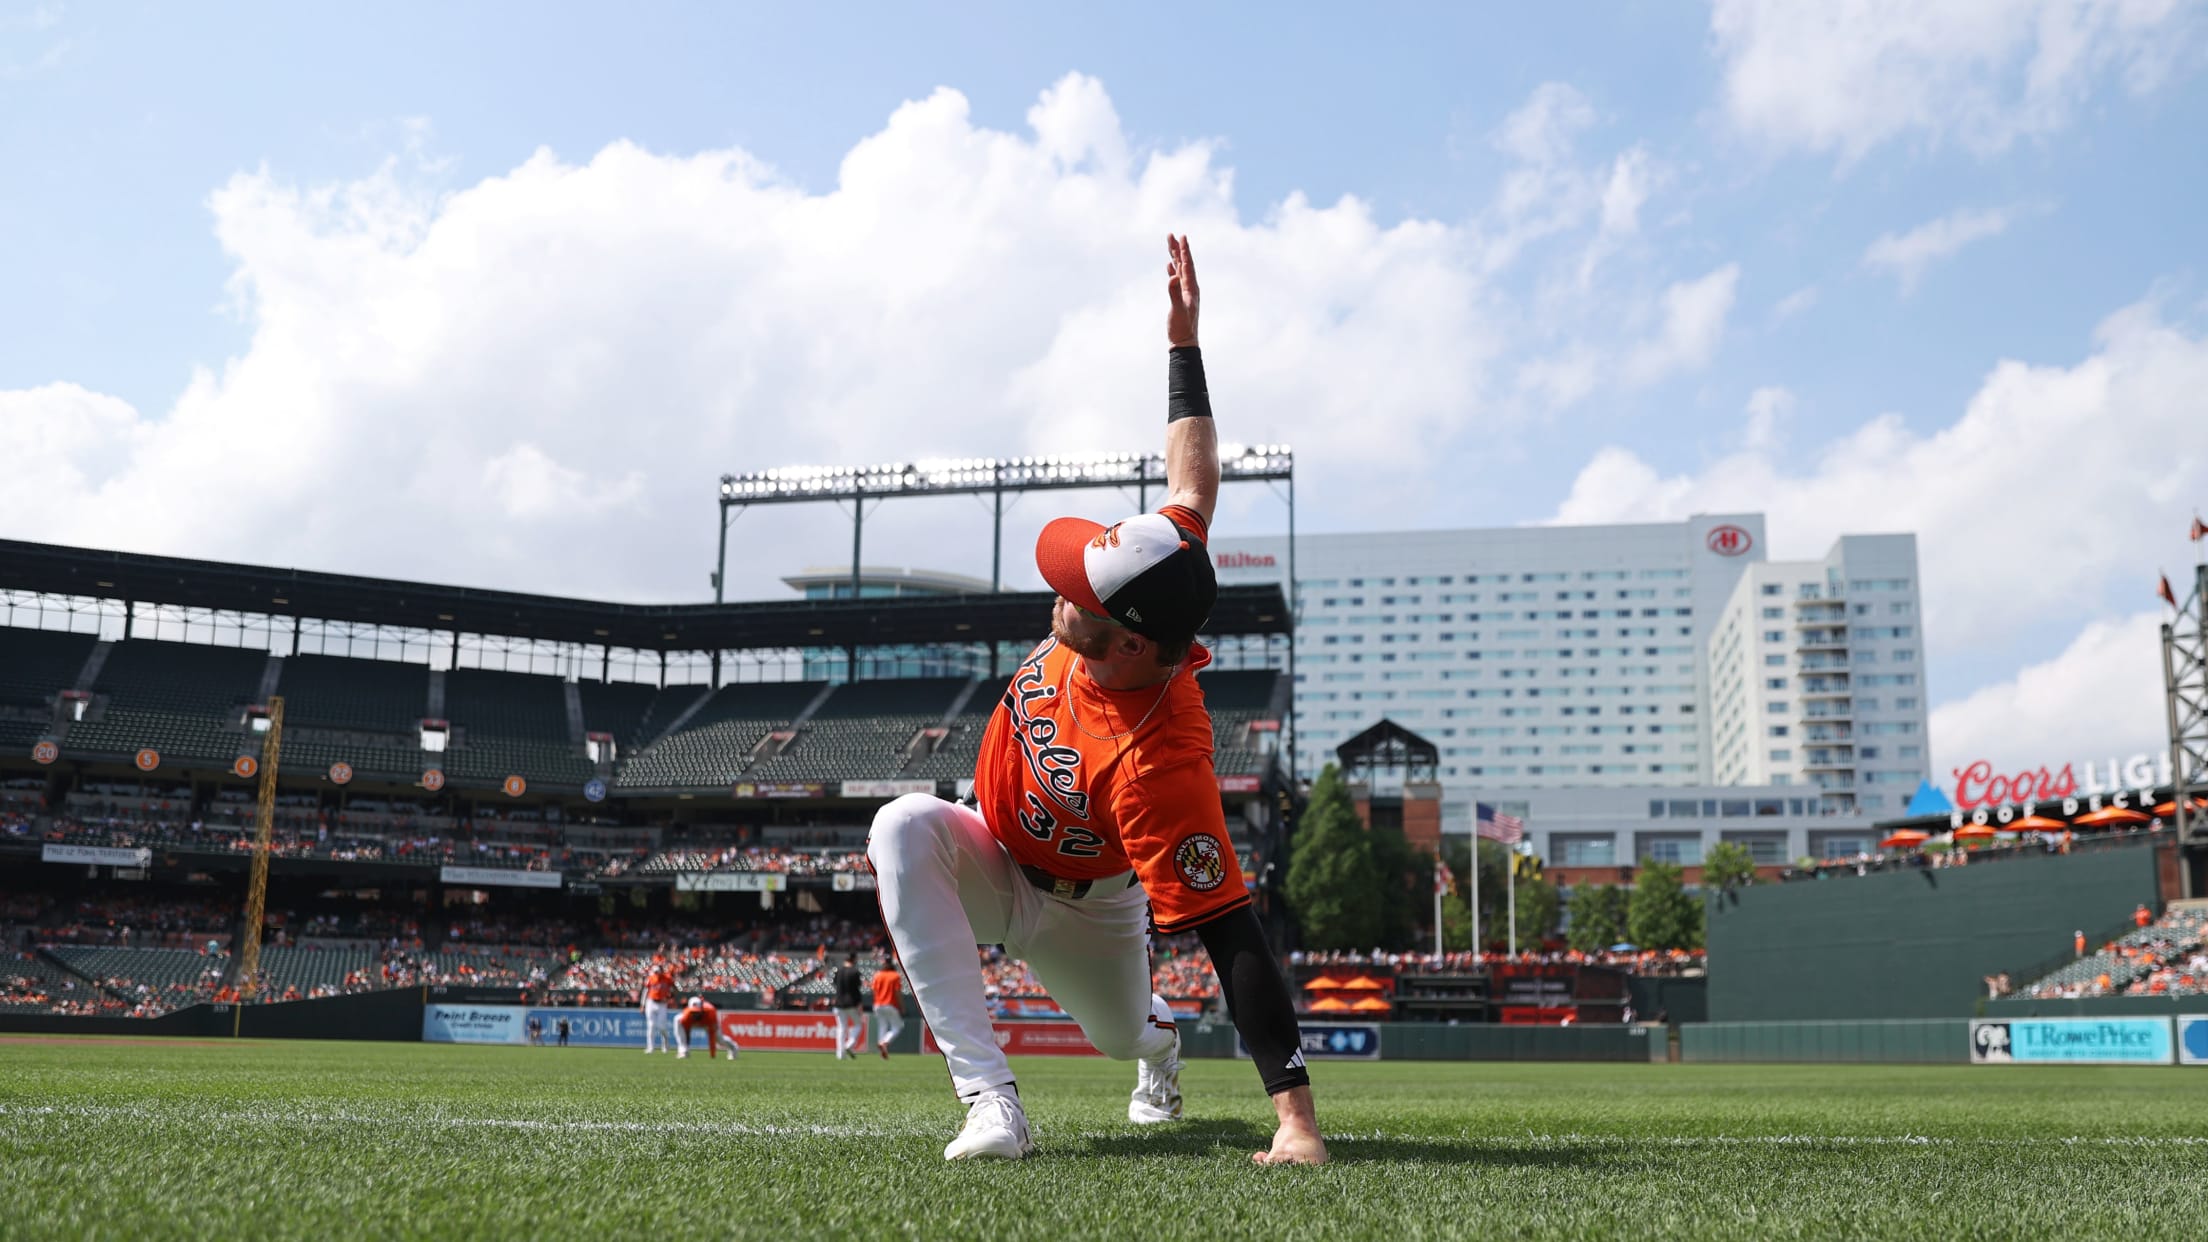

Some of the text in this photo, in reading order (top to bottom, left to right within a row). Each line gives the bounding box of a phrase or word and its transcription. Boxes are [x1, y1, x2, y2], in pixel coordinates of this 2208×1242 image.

[1217, 551, 1276, 568] Hilton
[1953, 760, 2079, 810] Coors
[1950, 789, 2157, 829] ROOF DECK
[1018, 791, 1104, 858] 32
[1176, 835, 1220, 861] BALTIMORE
[1190, 871, 1225, 889] ORIOLES
[469, 1011, 512, 1023] Breeze
[532, 1016, 621, 1038] ECOM
[729, 1020, 773, 1038] weis
[775, 1021, 840, 1039] marke
